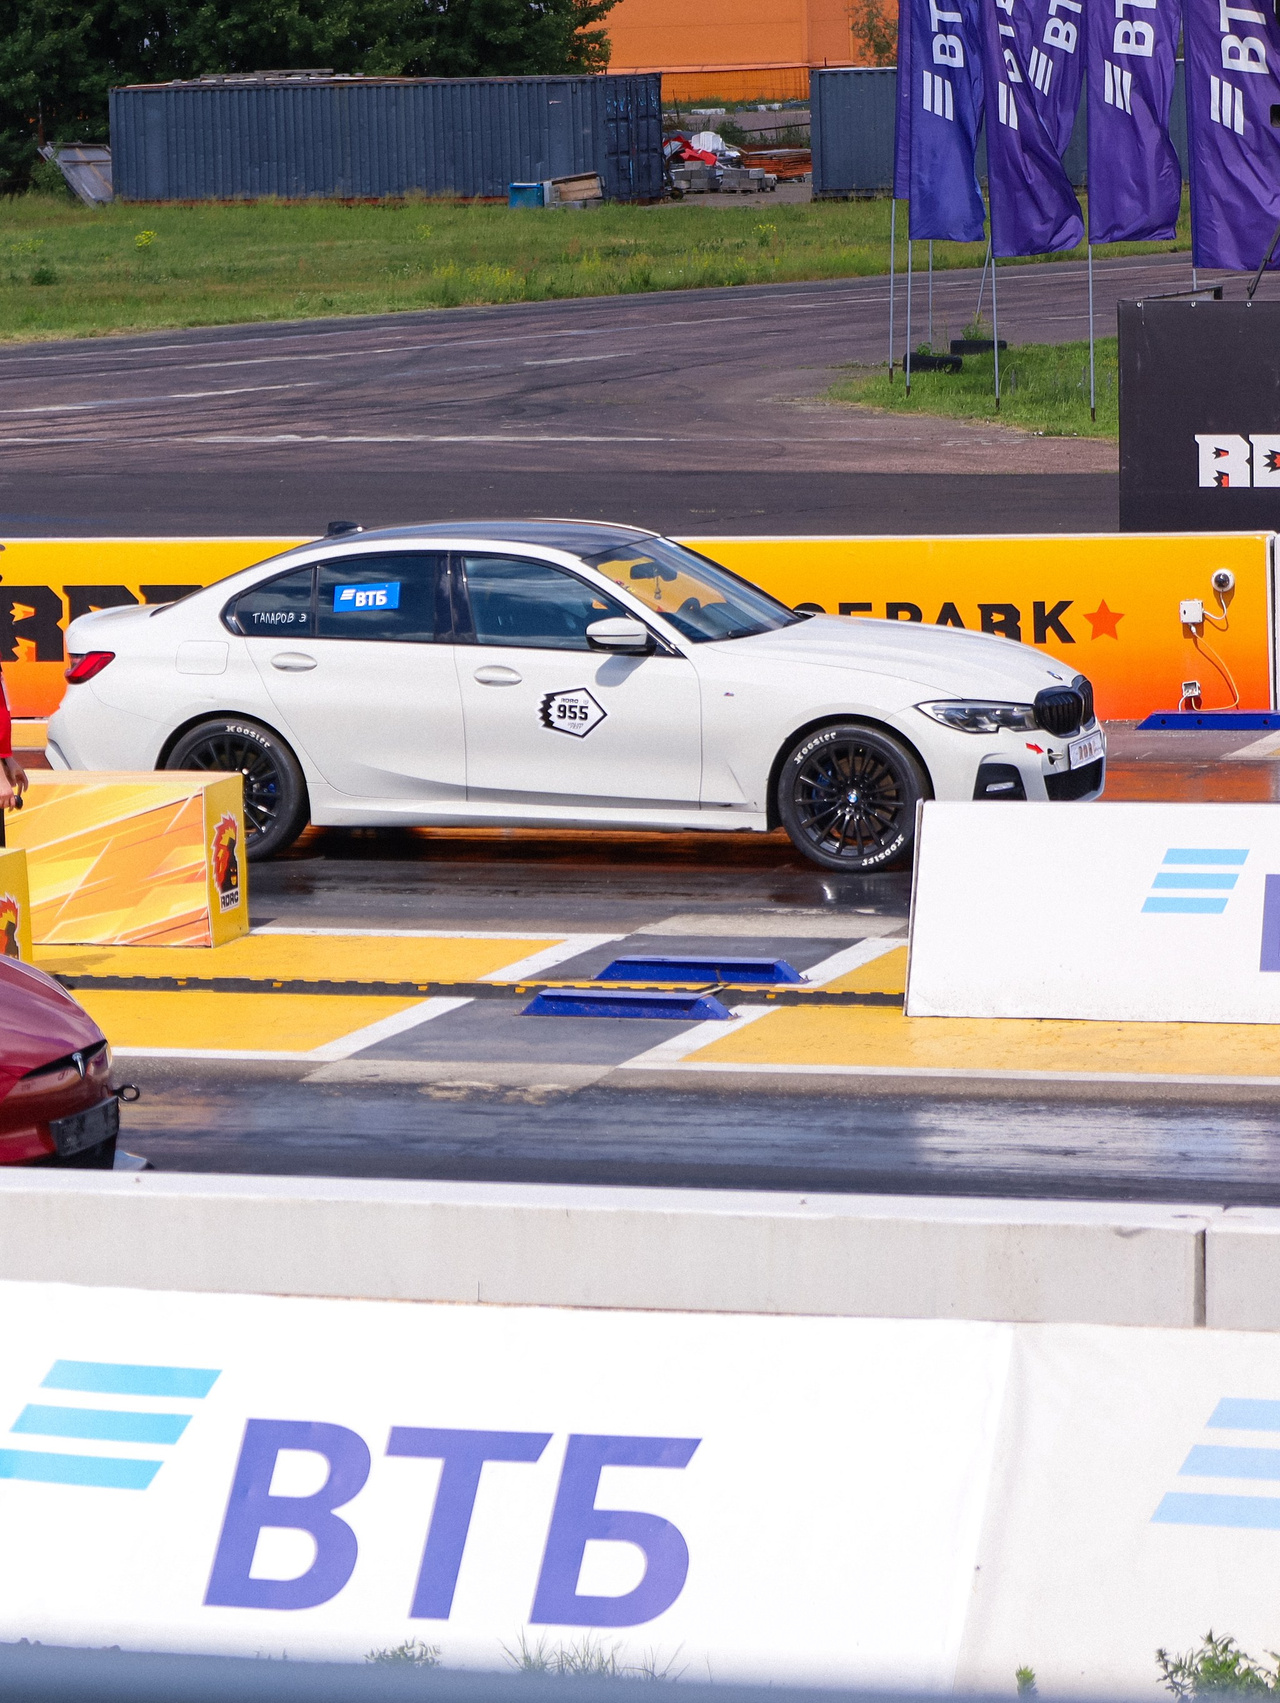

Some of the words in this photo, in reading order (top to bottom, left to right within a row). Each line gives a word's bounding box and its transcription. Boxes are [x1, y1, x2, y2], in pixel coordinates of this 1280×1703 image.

[355, 590, 388, 607] ВТБ
[556, 704, 589, 721] 955
[202, 1417, 704, 1628] ВТБ
